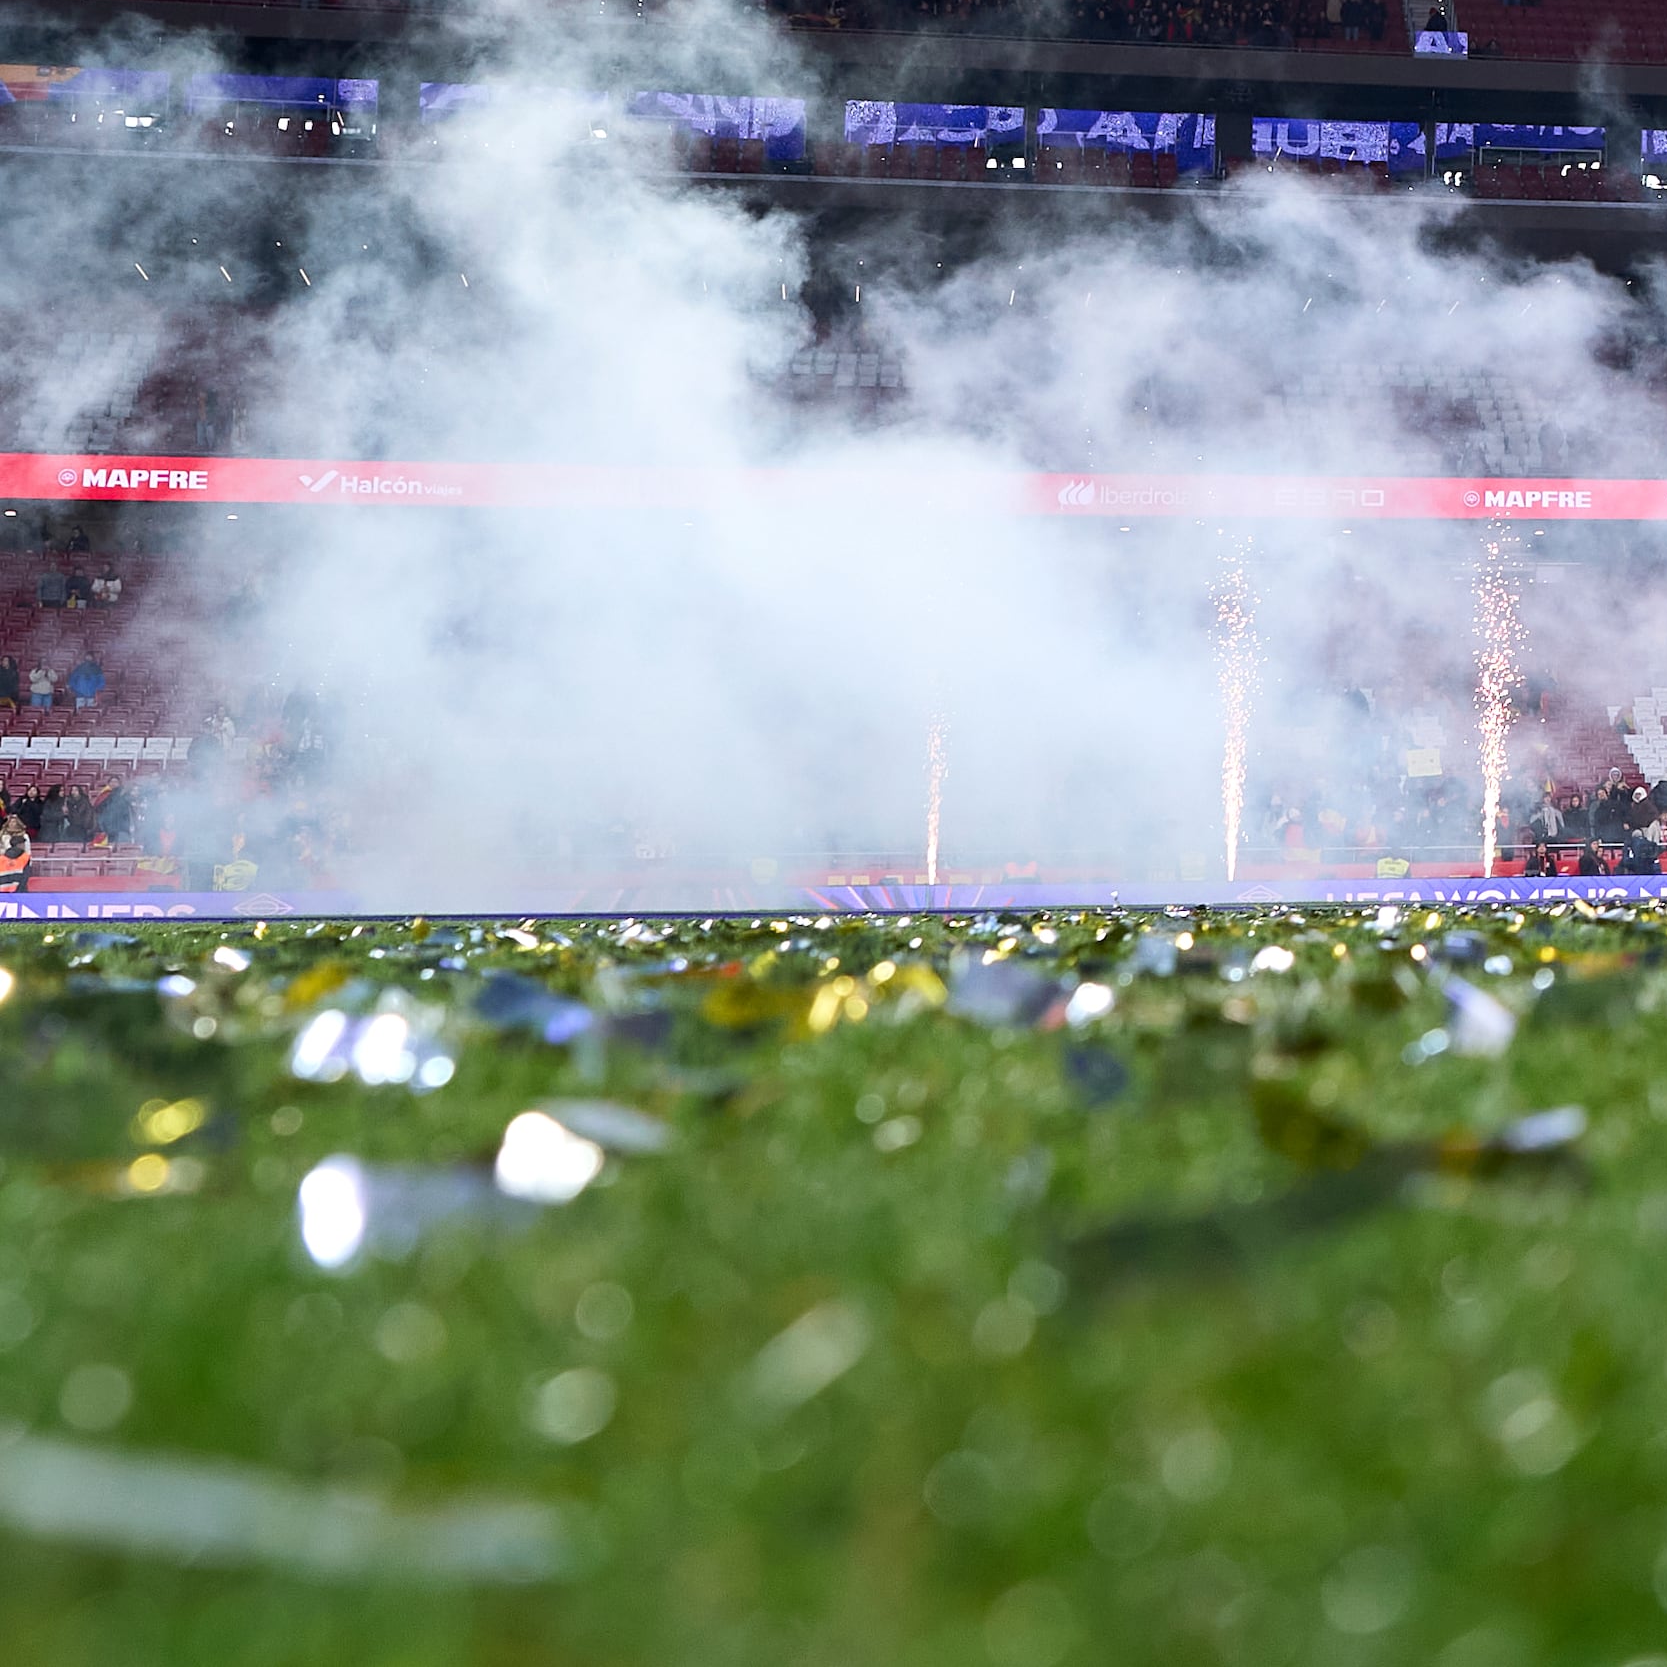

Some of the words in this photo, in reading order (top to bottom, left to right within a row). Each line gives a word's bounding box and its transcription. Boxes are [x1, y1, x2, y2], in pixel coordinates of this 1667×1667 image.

[82, 468, 208, 491] MAPFRE
[340, 474, 422, 495] Halcón
[1484, 490, 1592, 509] MAPFRE
